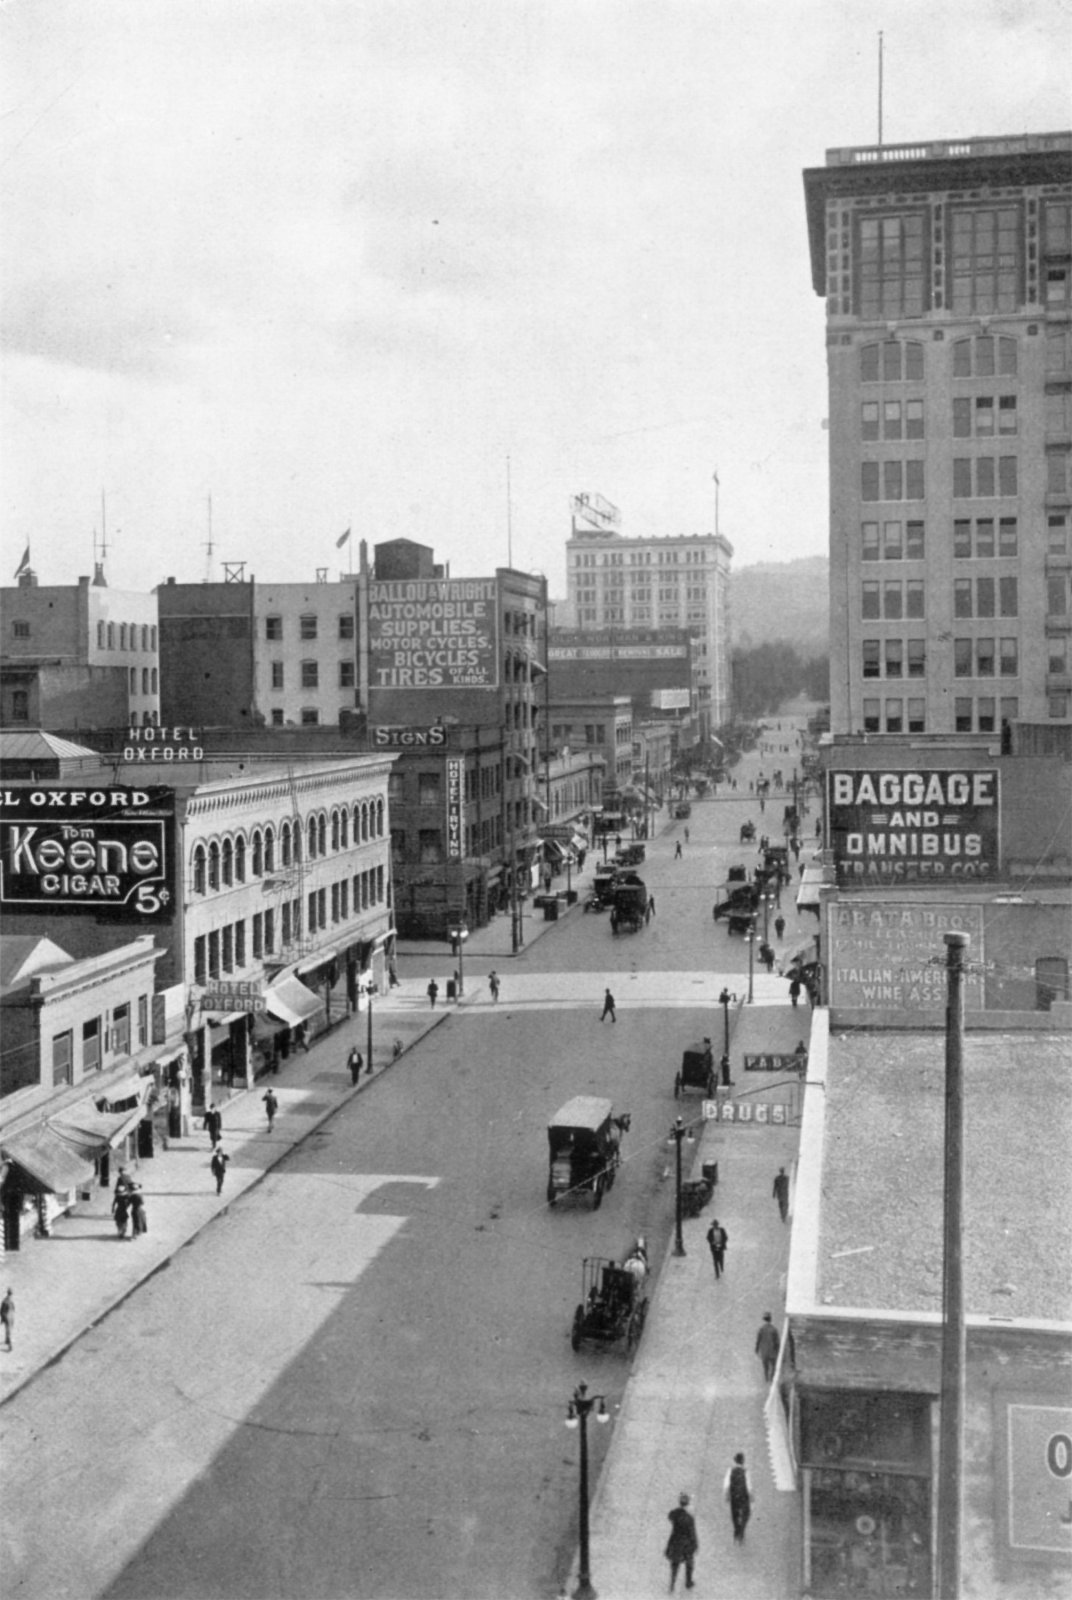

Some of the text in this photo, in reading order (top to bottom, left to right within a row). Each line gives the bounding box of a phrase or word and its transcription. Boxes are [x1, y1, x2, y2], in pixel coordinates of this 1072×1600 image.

[368, 583, 424, 603] BALLOU
[369, 601, 487, 620] AUTOMOBILE
[381, 619, 482, 637] SUPPLIES,
[371, 637, 421, 650] MOTOR
[394, 650, 479, 667] BICYCLES
[377, 667, 489, 686] TIRES OF ALL
[129, 727, 198, 741] HOTEL
[375, 726, 445, 745] SIGNS
[124, 747, 204, 761] OXFORD
[449, 761, 459, 804] HOTEL
[833, 773, 994, 806] BAGGAGE
[30, 791, 150, 806] OXFORD
[889, 811, 940, 828] AND
[61, 825, 95, 840] Tom
[9, 826, 158, 875] Keene
[846, 833, 982, 855] OMNIBUS
[41, 875, 121, 896] CIGAR
[209, 983, 260, 996] HOTEL
[862, 985, 903, 1001] WINE
[204, 998, 264, 1012] OXFORD
[706, 1103, 785, 1124] DRUGS
